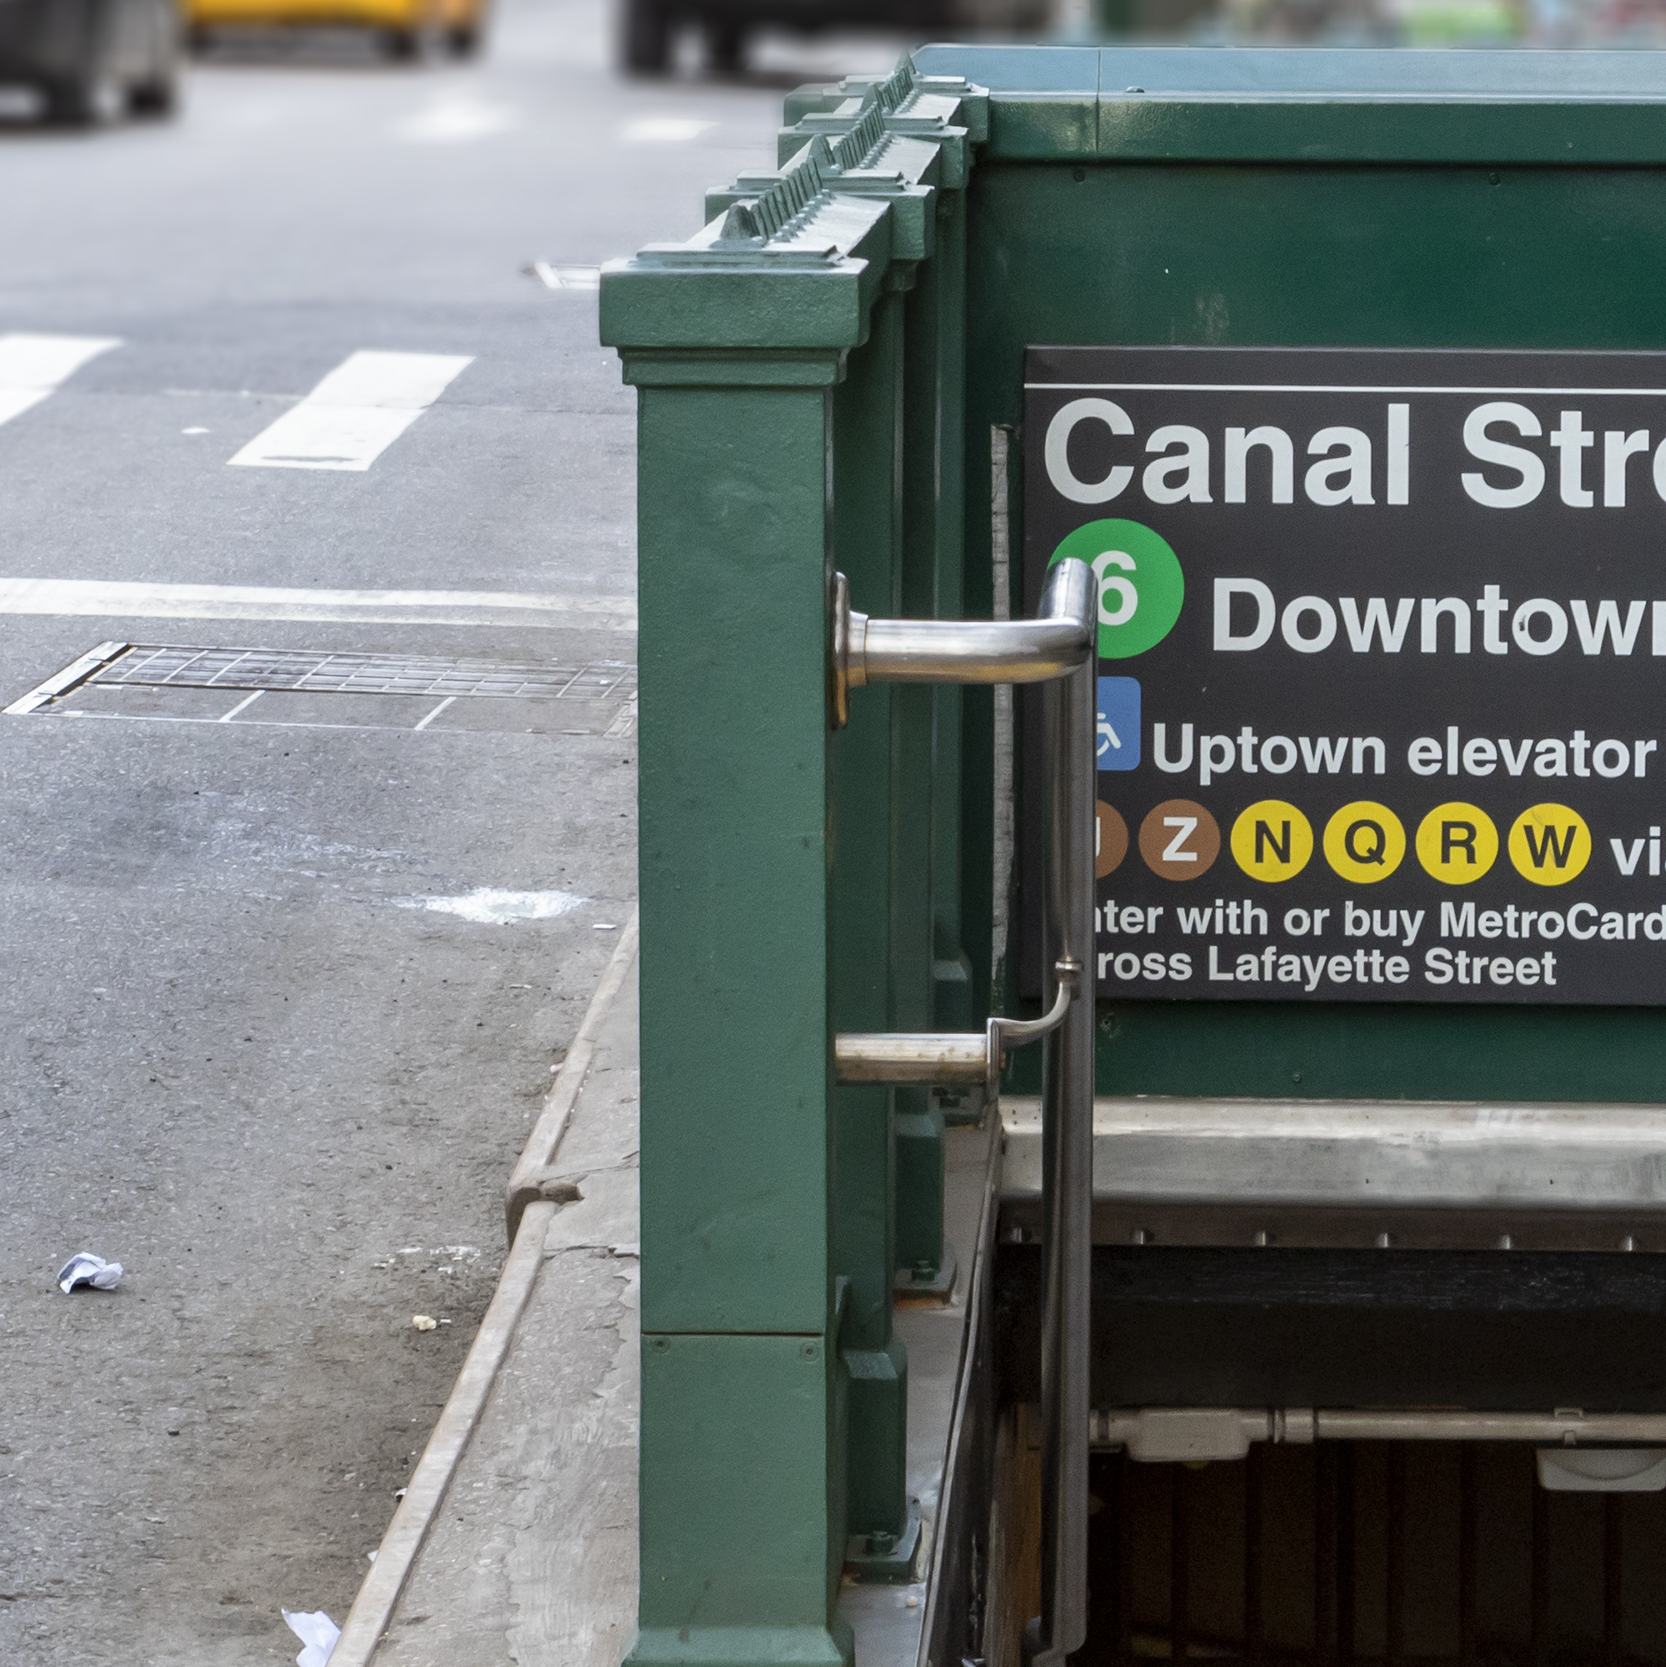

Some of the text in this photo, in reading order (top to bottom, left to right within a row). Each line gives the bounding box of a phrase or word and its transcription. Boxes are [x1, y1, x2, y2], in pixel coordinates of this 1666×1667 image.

[1045, 398, 1409, 506] Canal
[1097, 550, 1139, 627] 6
[1154, 723, 1385, 785] Uptown
[1408, 726, 1657, 778] elevator
[1162, 817, 1198, 861] Z
[1256, 821, 1290, 863] N
[1345, 820, 1385, 865] Q
[1442, 821, 1476, 863] R
[1524, 826, 1576, 868] W
[1097, 901, 1163, 933] ter
[1177, 899, 1267, 934] with
[1284, 909, 1330, 935] or
[1345, 901, 1425, 946] buy
[1098, 946, 1556, 991] ross Lafayette Street
